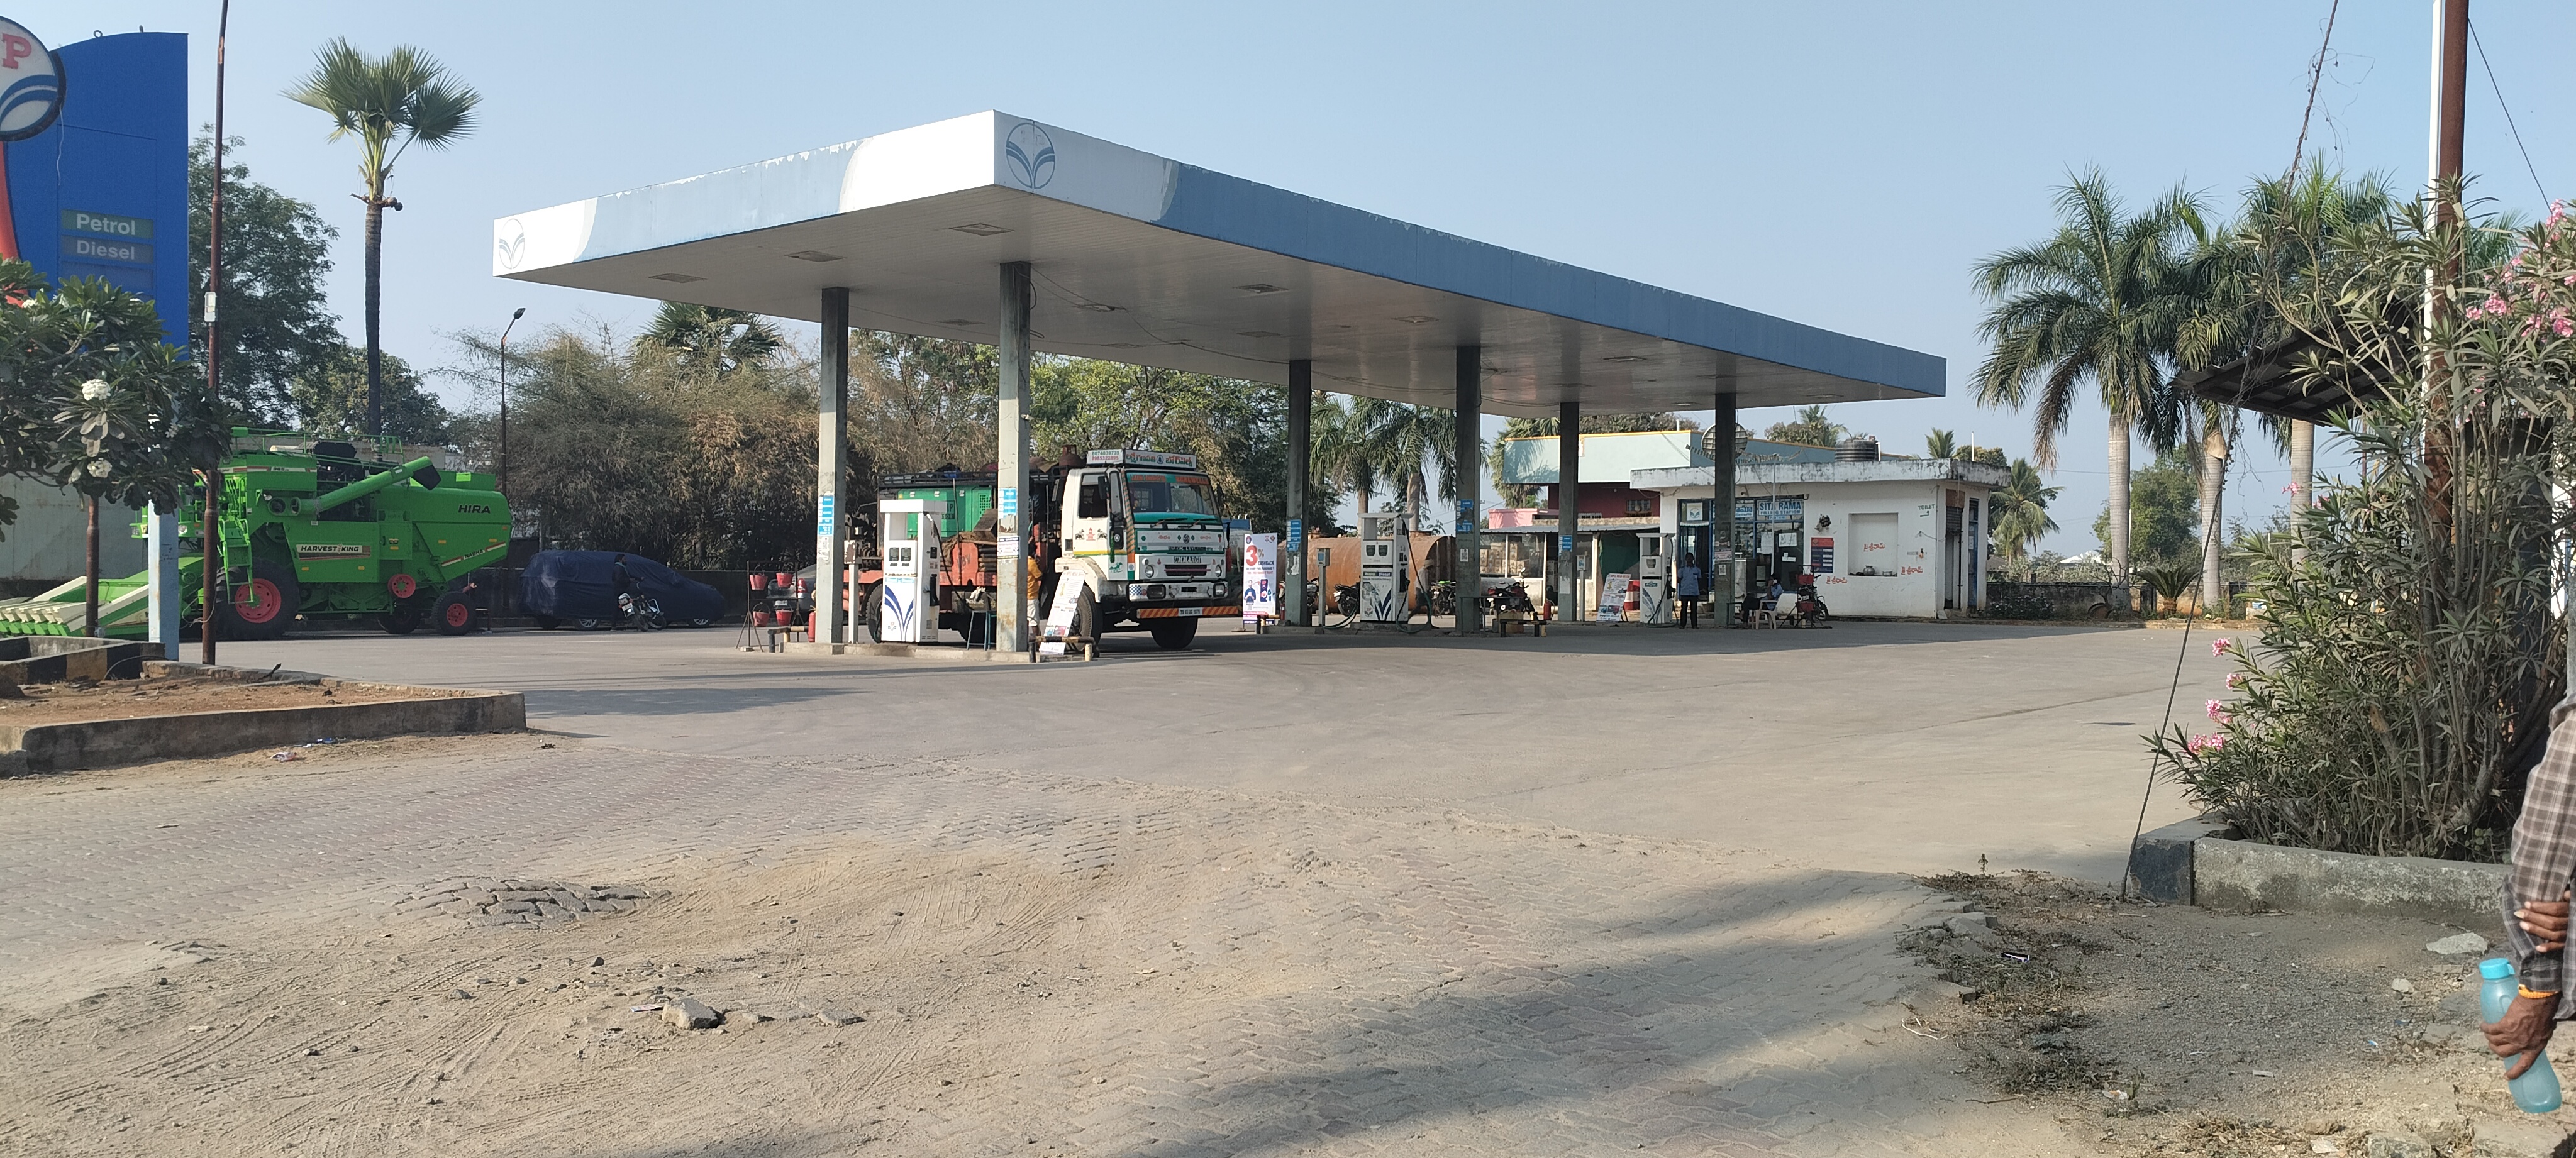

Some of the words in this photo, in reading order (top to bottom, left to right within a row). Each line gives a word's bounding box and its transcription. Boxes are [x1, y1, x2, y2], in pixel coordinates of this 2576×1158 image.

[77, 213, 135, 235] Petrol
[77, 240, 135, 260] Diesel
[458, 505, 491, 514] HIRA
[1779, 501, 1801, 510] RAMA
[465, 549, 483, 558] NABHA
